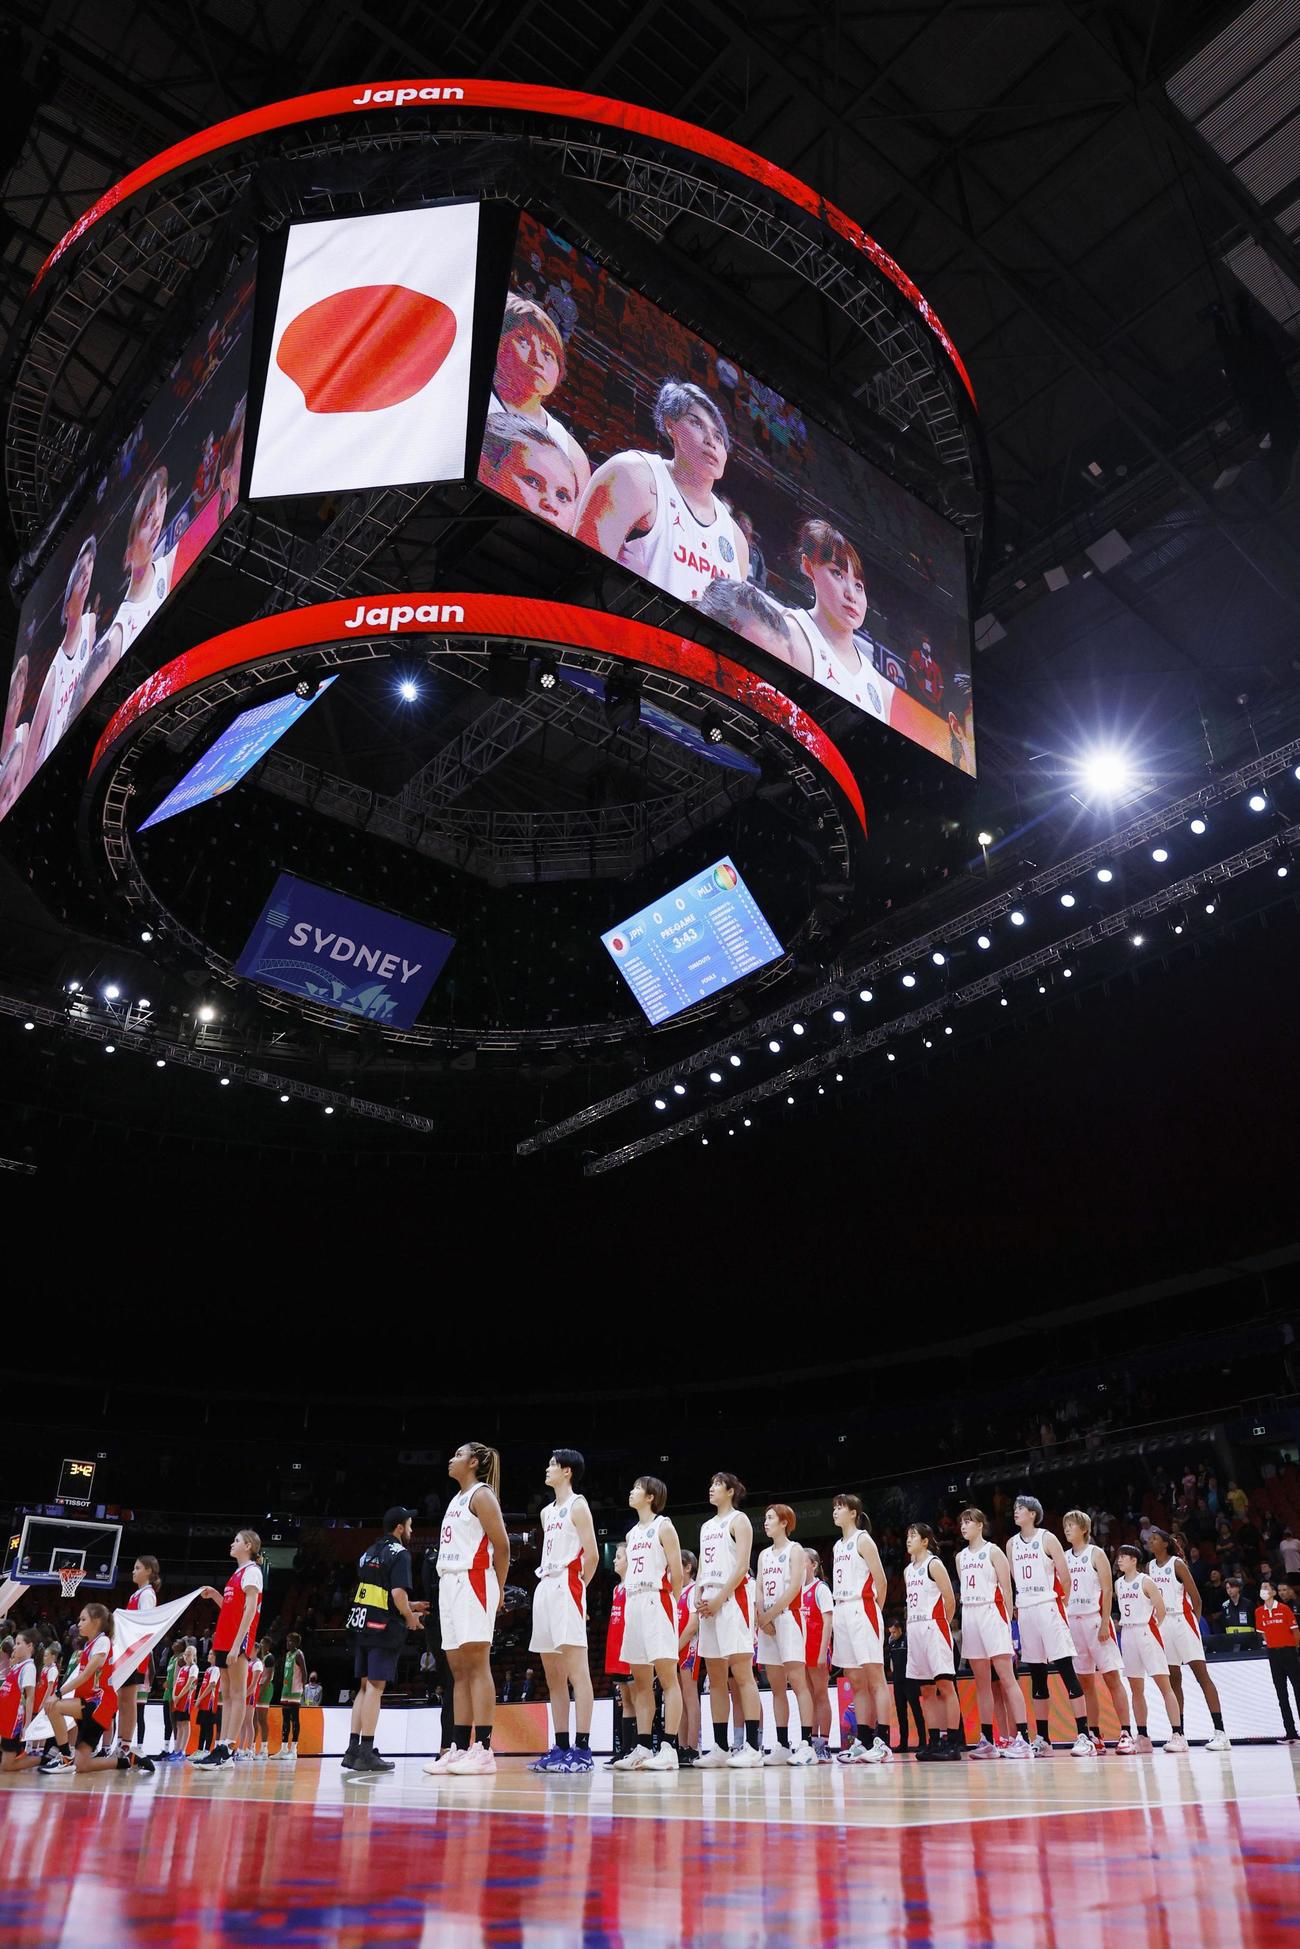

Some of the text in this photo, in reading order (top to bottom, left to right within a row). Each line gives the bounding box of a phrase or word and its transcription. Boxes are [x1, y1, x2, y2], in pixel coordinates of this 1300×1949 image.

[353, 87, 464, 106] Japan
[344, 605, 465, 631] Japan
[697, 882, 714, 897] MLI
[629, 898, 686, 941] JPN 0 0
[660, 913, 696, 939] PRE-GAME
[672, 928, 697, 949] 3:43
[288, 922, 422, 984] SYDNEY
[70, 1463, 93, 1477] 3:42
[65, 1499, 91, 1507] TISSOT
[632, 1542, 652, 1551] APAN
[1015, 1553, 1038, 1561] JAPAN
[632, 1556, 644, 1575] 75
[763, 1567, 783, 1575] JAPAN
[1022, 1565, 1032, 1579] 10
[837, 1568, 842, 1584] 3
[908, 1579, 924, 1587] APAN
[966, 1574, 976, 1589] 14
[1073, 1578, 1078, 1591] 8
[1124, 1604, 1131, 1617] 5
